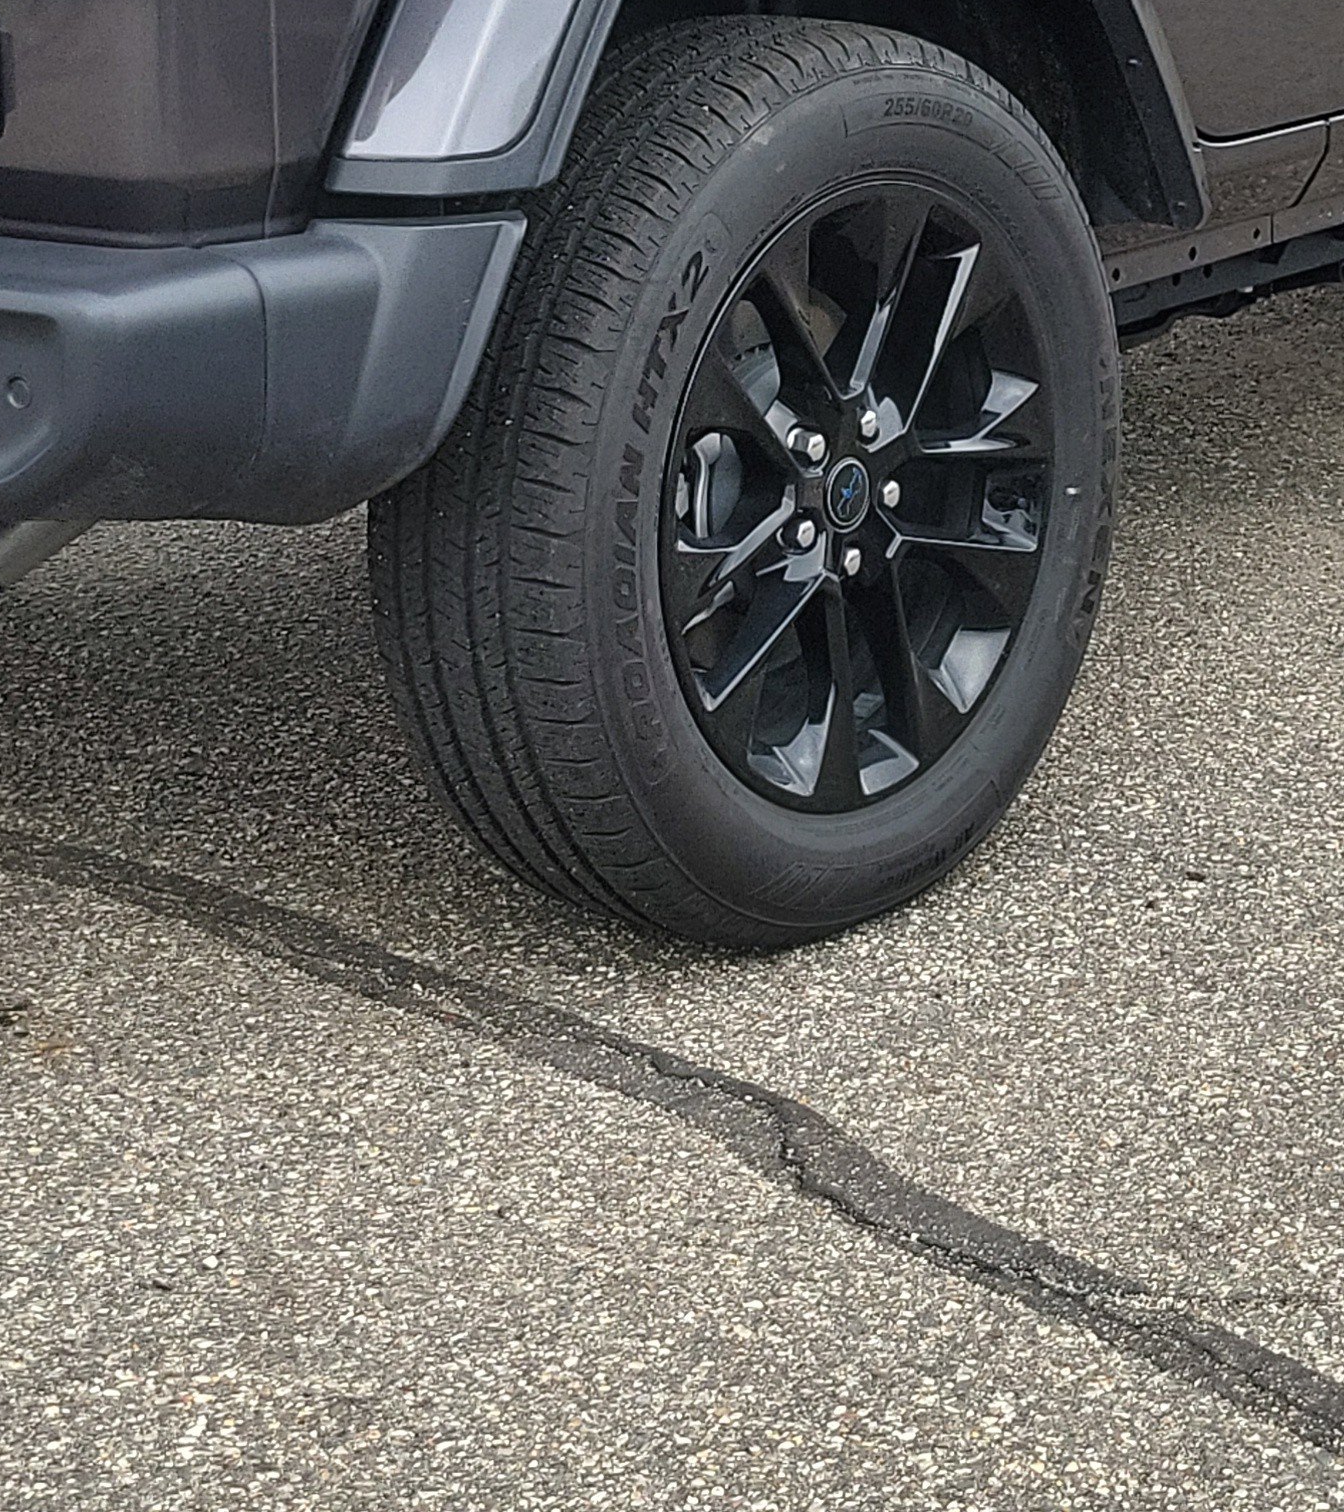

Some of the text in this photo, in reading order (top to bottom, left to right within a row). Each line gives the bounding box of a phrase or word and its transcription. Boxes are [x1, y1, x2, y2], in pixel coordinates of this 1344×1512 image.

[884, 96, 973, 128] 255/60R20
[613, 250, 709, 750] ROADIAN HTX2
